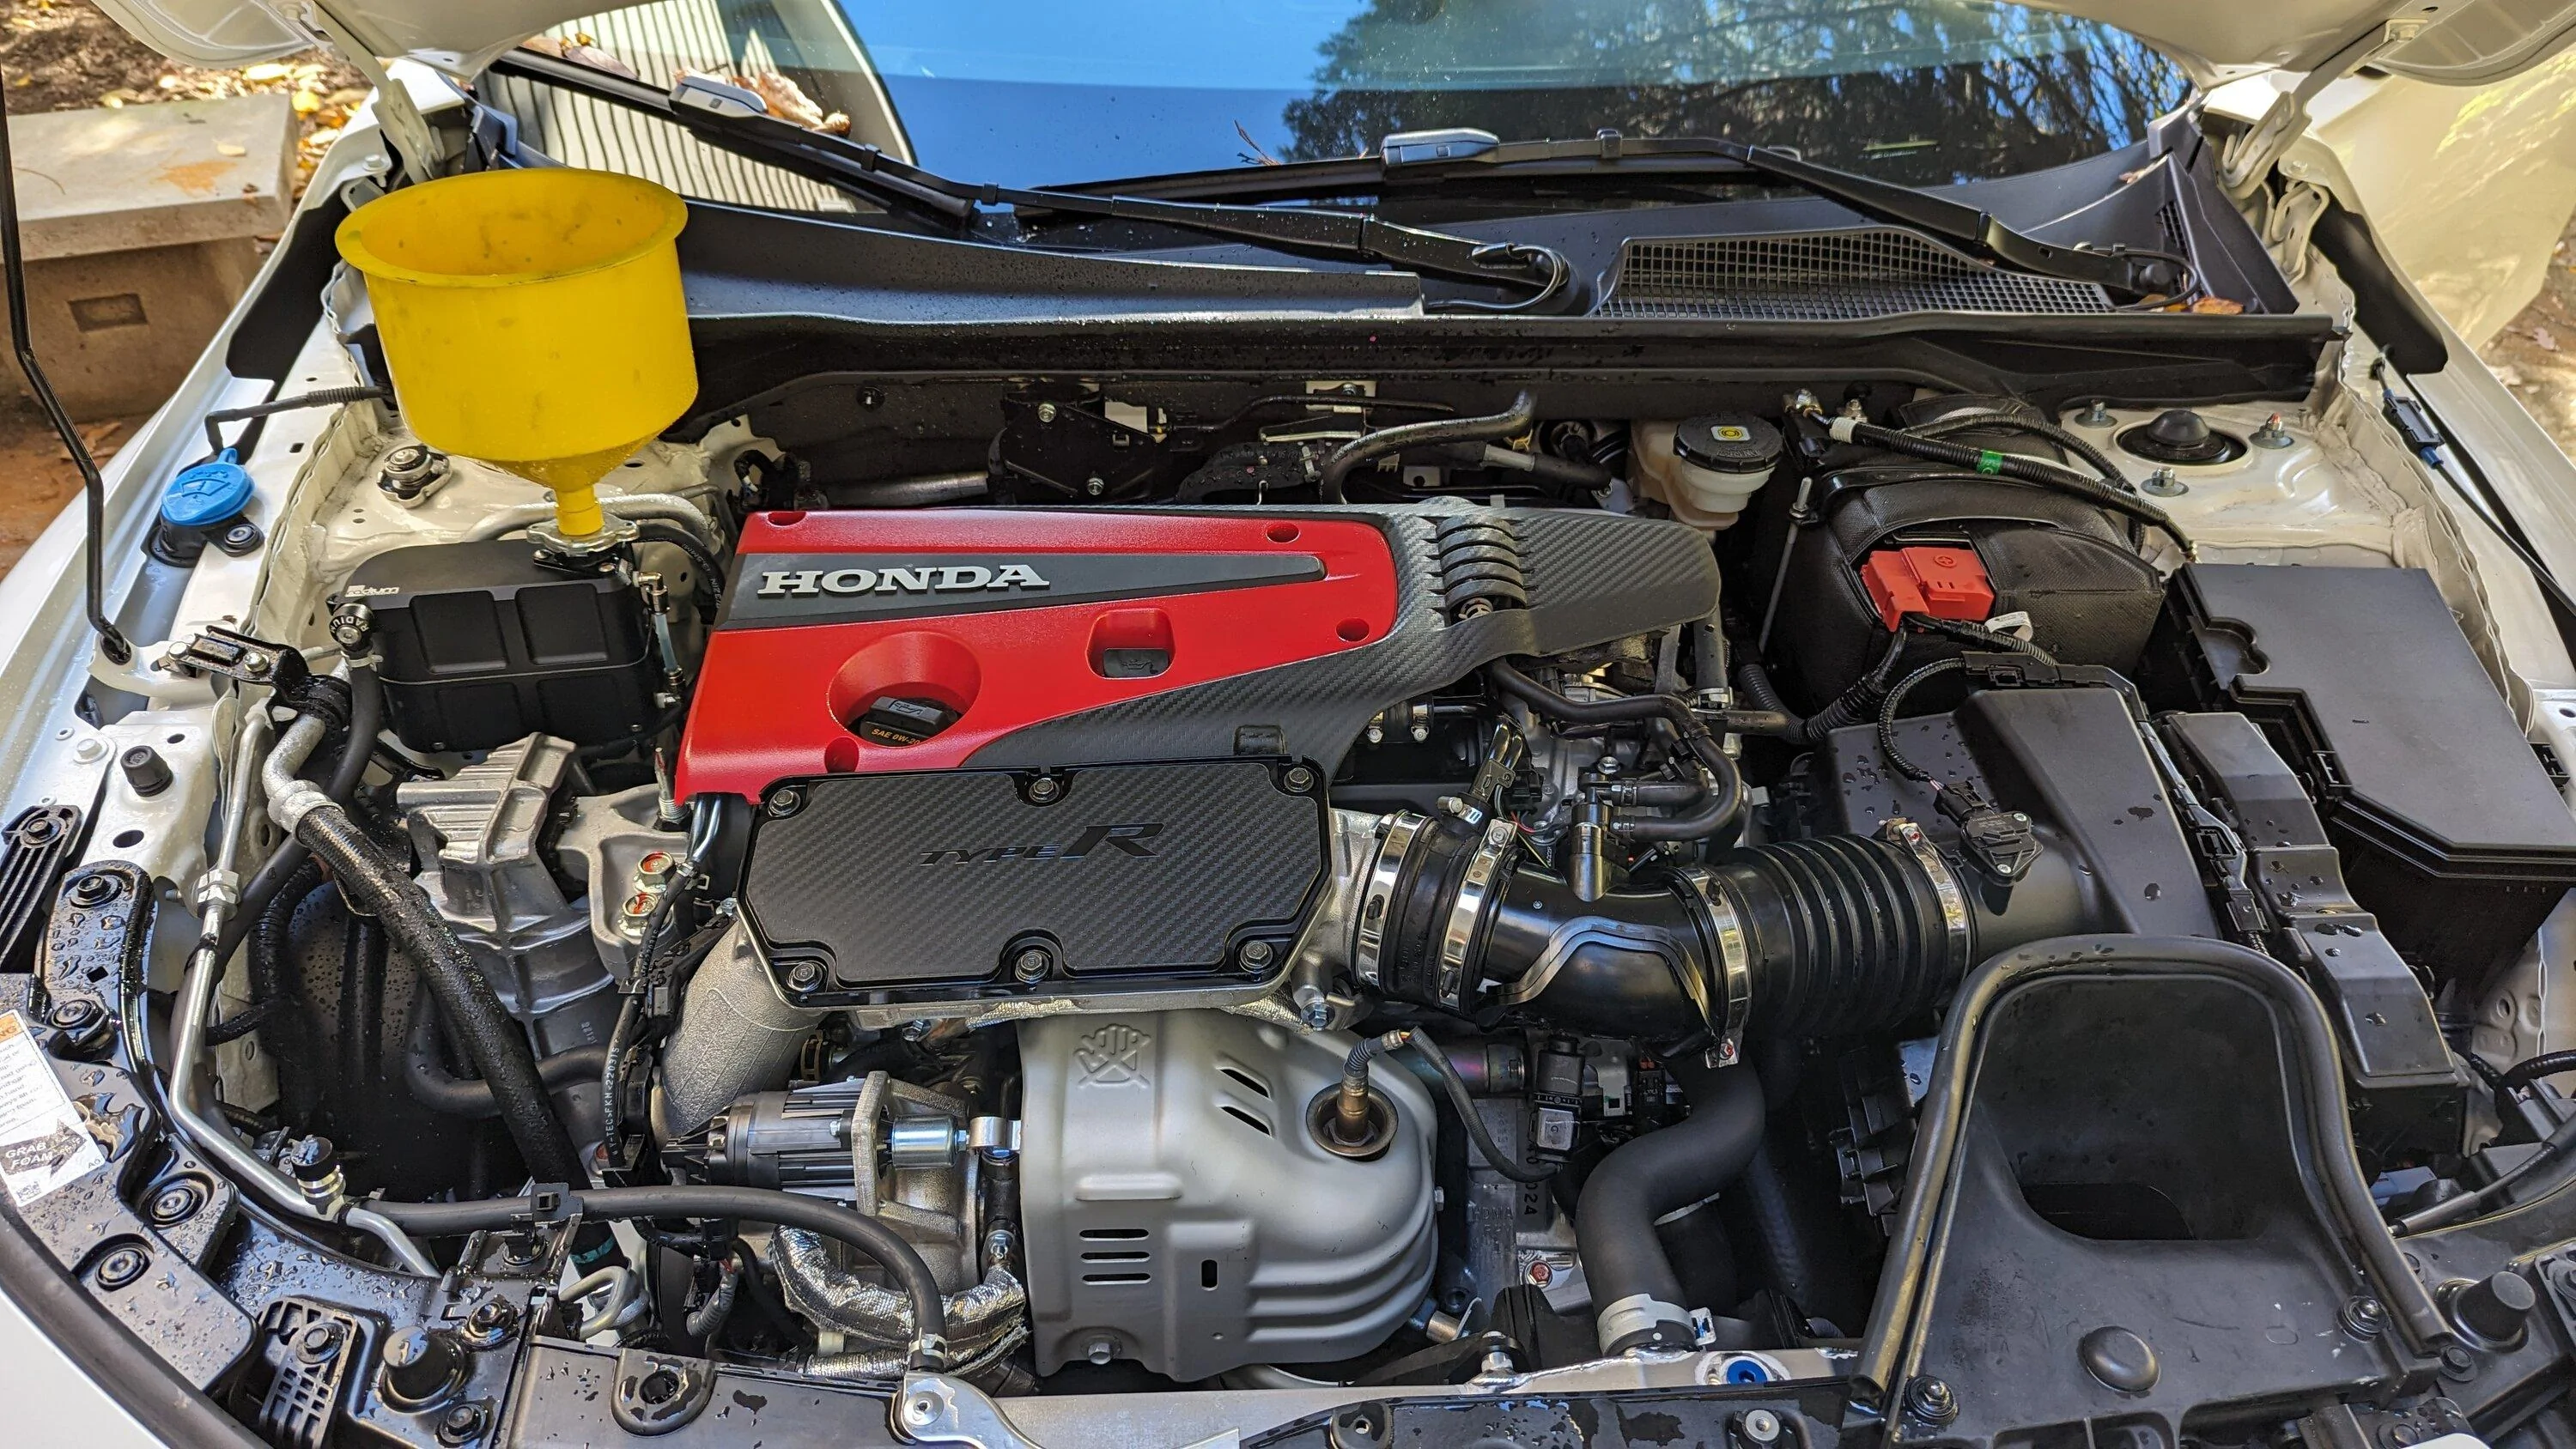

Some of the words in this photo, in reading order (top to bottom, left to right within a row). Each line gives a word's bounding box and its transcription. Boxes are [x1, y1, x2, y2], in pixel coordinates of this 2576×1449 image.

[757, 564, 1050, 598] HONDA
[330, 615, 370, 634] RADIUM
[872, 728, 893, 738] SAE
[892, 734, 920, 745] 0W-20
[920, 844, 1062, 866] TYPE
[1060, 822, 1164, 860] R
[5, 1142, 47, 1159] GRAB
[11, 1152, 53, 1170] FOAM
